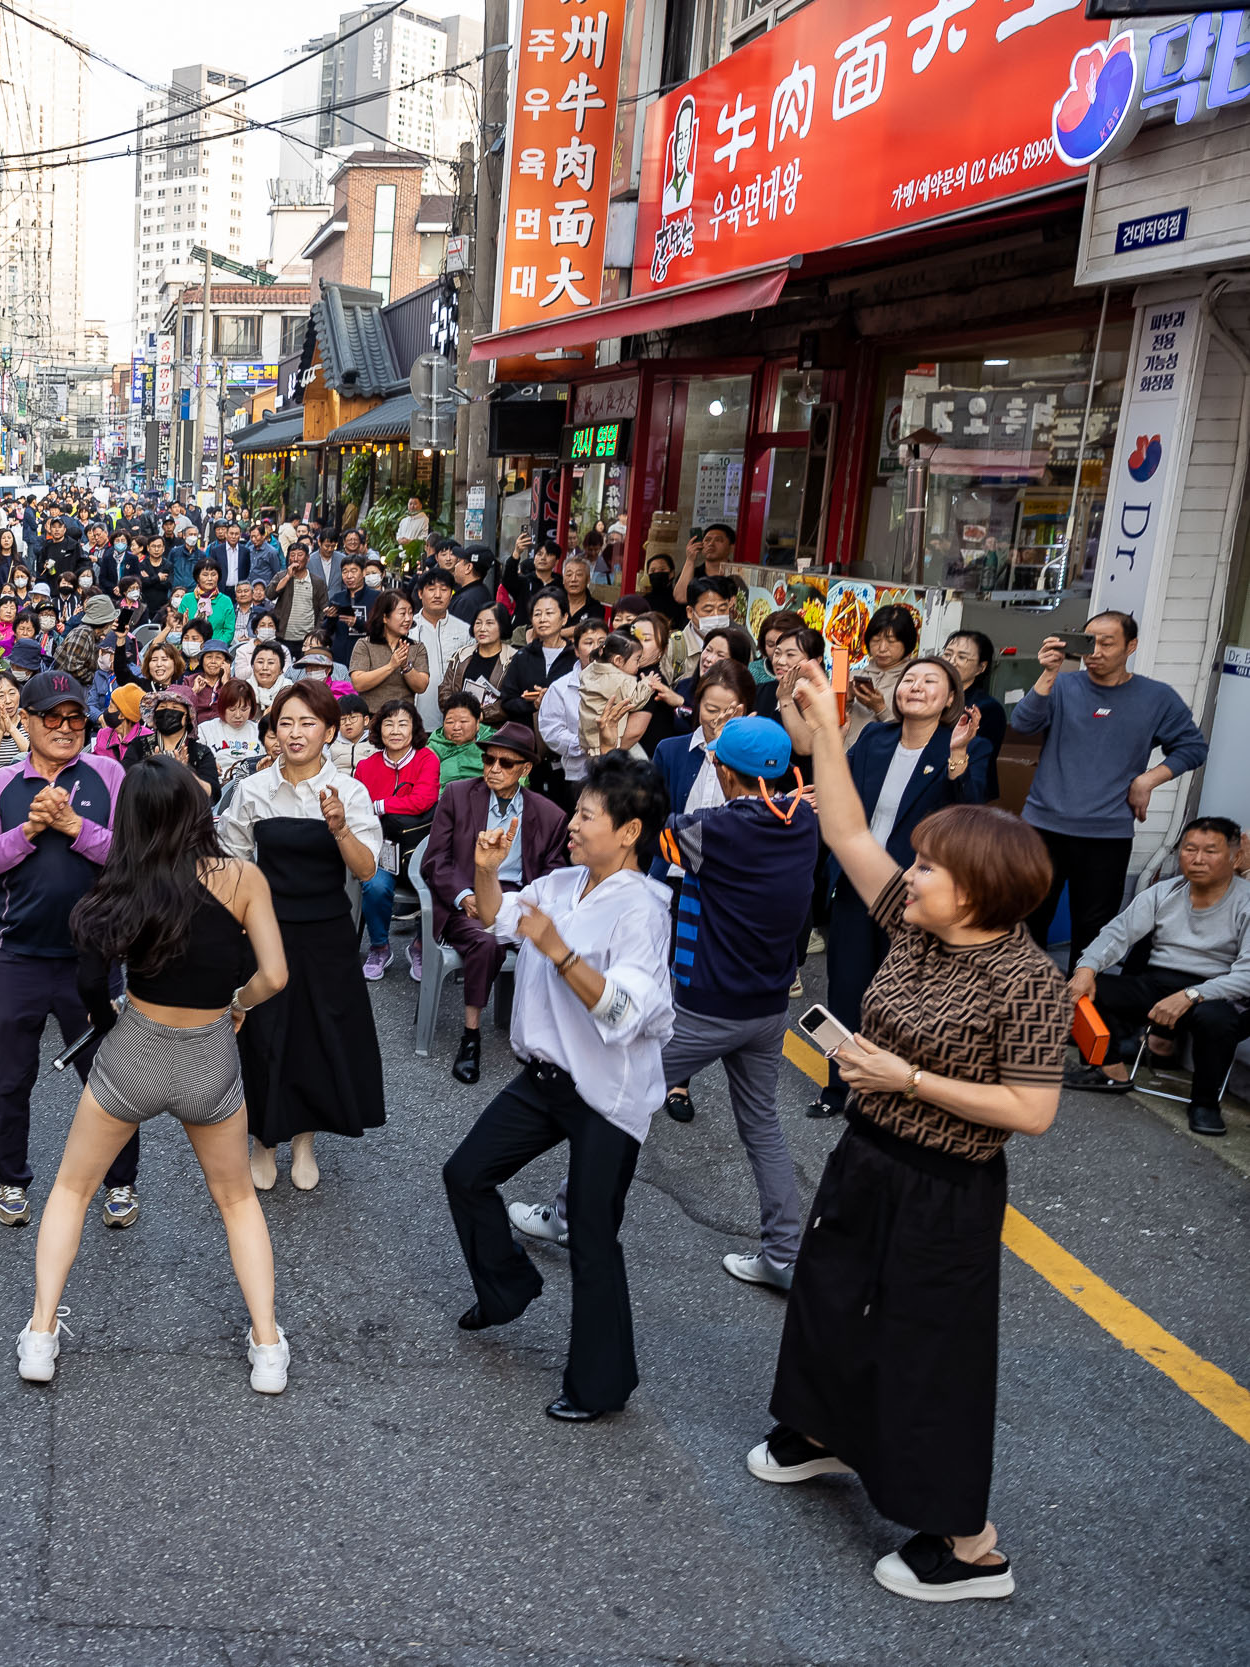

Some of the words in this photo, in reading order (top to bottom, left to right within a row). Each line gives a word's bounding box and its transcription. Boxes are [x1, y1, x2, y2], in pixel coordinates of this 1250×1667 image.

[372, 27, 383, 80] SUMMIT
[1100, 107, 1121, 141] KBF
[890, 162, 968, 210] 가맹/예약문의
[970, 158, 986, 185] 02
[989, 146, 1020, 180] 6465
[1021, 135, 1054, 170] 8999
[709, 157, 803, 242] 우육면대왕
[1123, 213, 1181, 246] 건대직영점
[1152, 332, 1176, 352] 전용
[1143, 352, 1179, 371] 기능성
[1140, 373, 1175, 392] 화장품
[571, 427, 595, 458] 24시
[595, 424, 619, 457] 영업
[719, 457, 731, 466] 10
[1110, 501, 1151, 582] Dr.
[211, 739, 261, 755] LACOSTE
